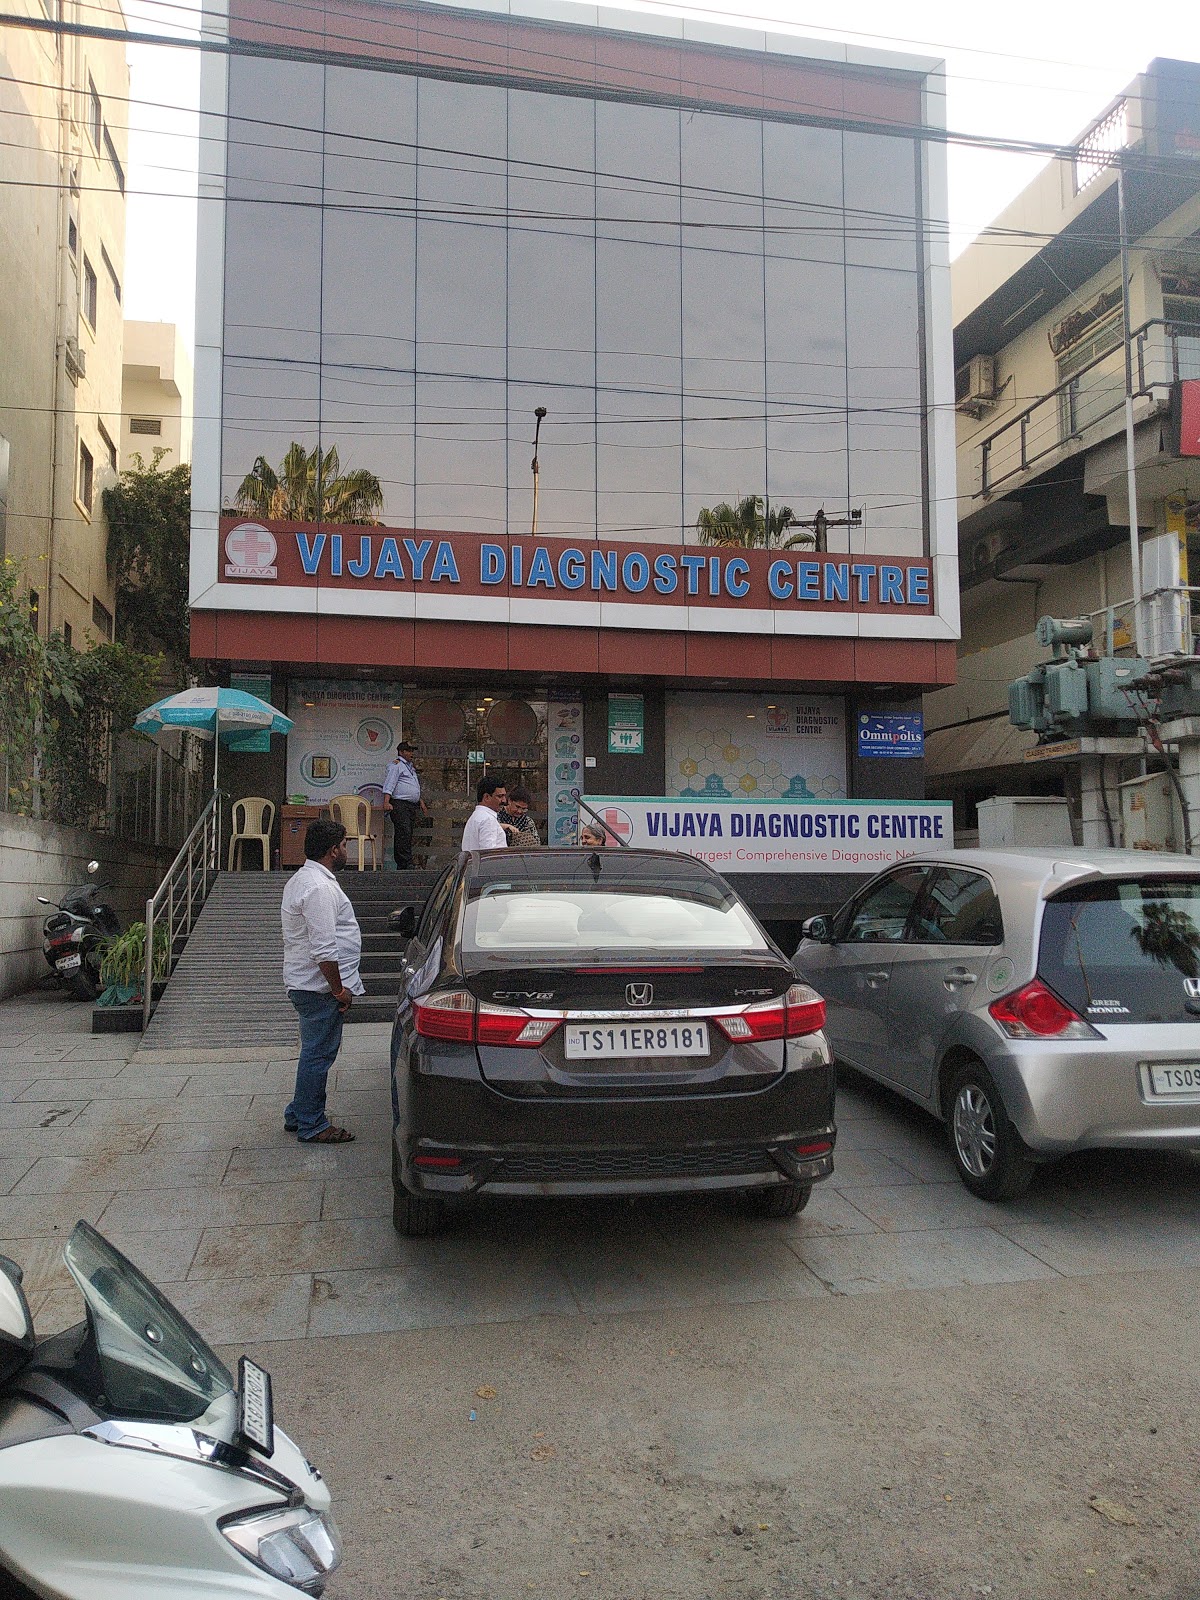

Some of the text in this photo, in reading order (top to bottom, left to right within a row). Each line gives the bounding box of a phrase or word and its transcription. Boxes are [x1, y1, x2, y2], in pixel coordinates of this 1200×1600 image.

[229, 567, 273, 575] VIJAYA
[296, 532, 931, 605] VIJAYA DIAGNOSTIC CENTRE
[796, 706, 821, 715] VIJAYA
[796, 716, 838, 725] DIAGNOSTIC
[796, 725, 823, 734] CENTRE
[860, 729, 922, 744] Omnipolis
[646, 812, 944, 839] VIJAYA DIAGNOSTIC CENTRE
[736, 848, 828, 862] Comprehensive
[831, 849, 892, 863] Diagnostic
[1086, 1006, 1131, 1014] HONDA
[568, 1027, 705, 1051] IND TS11ER8181
